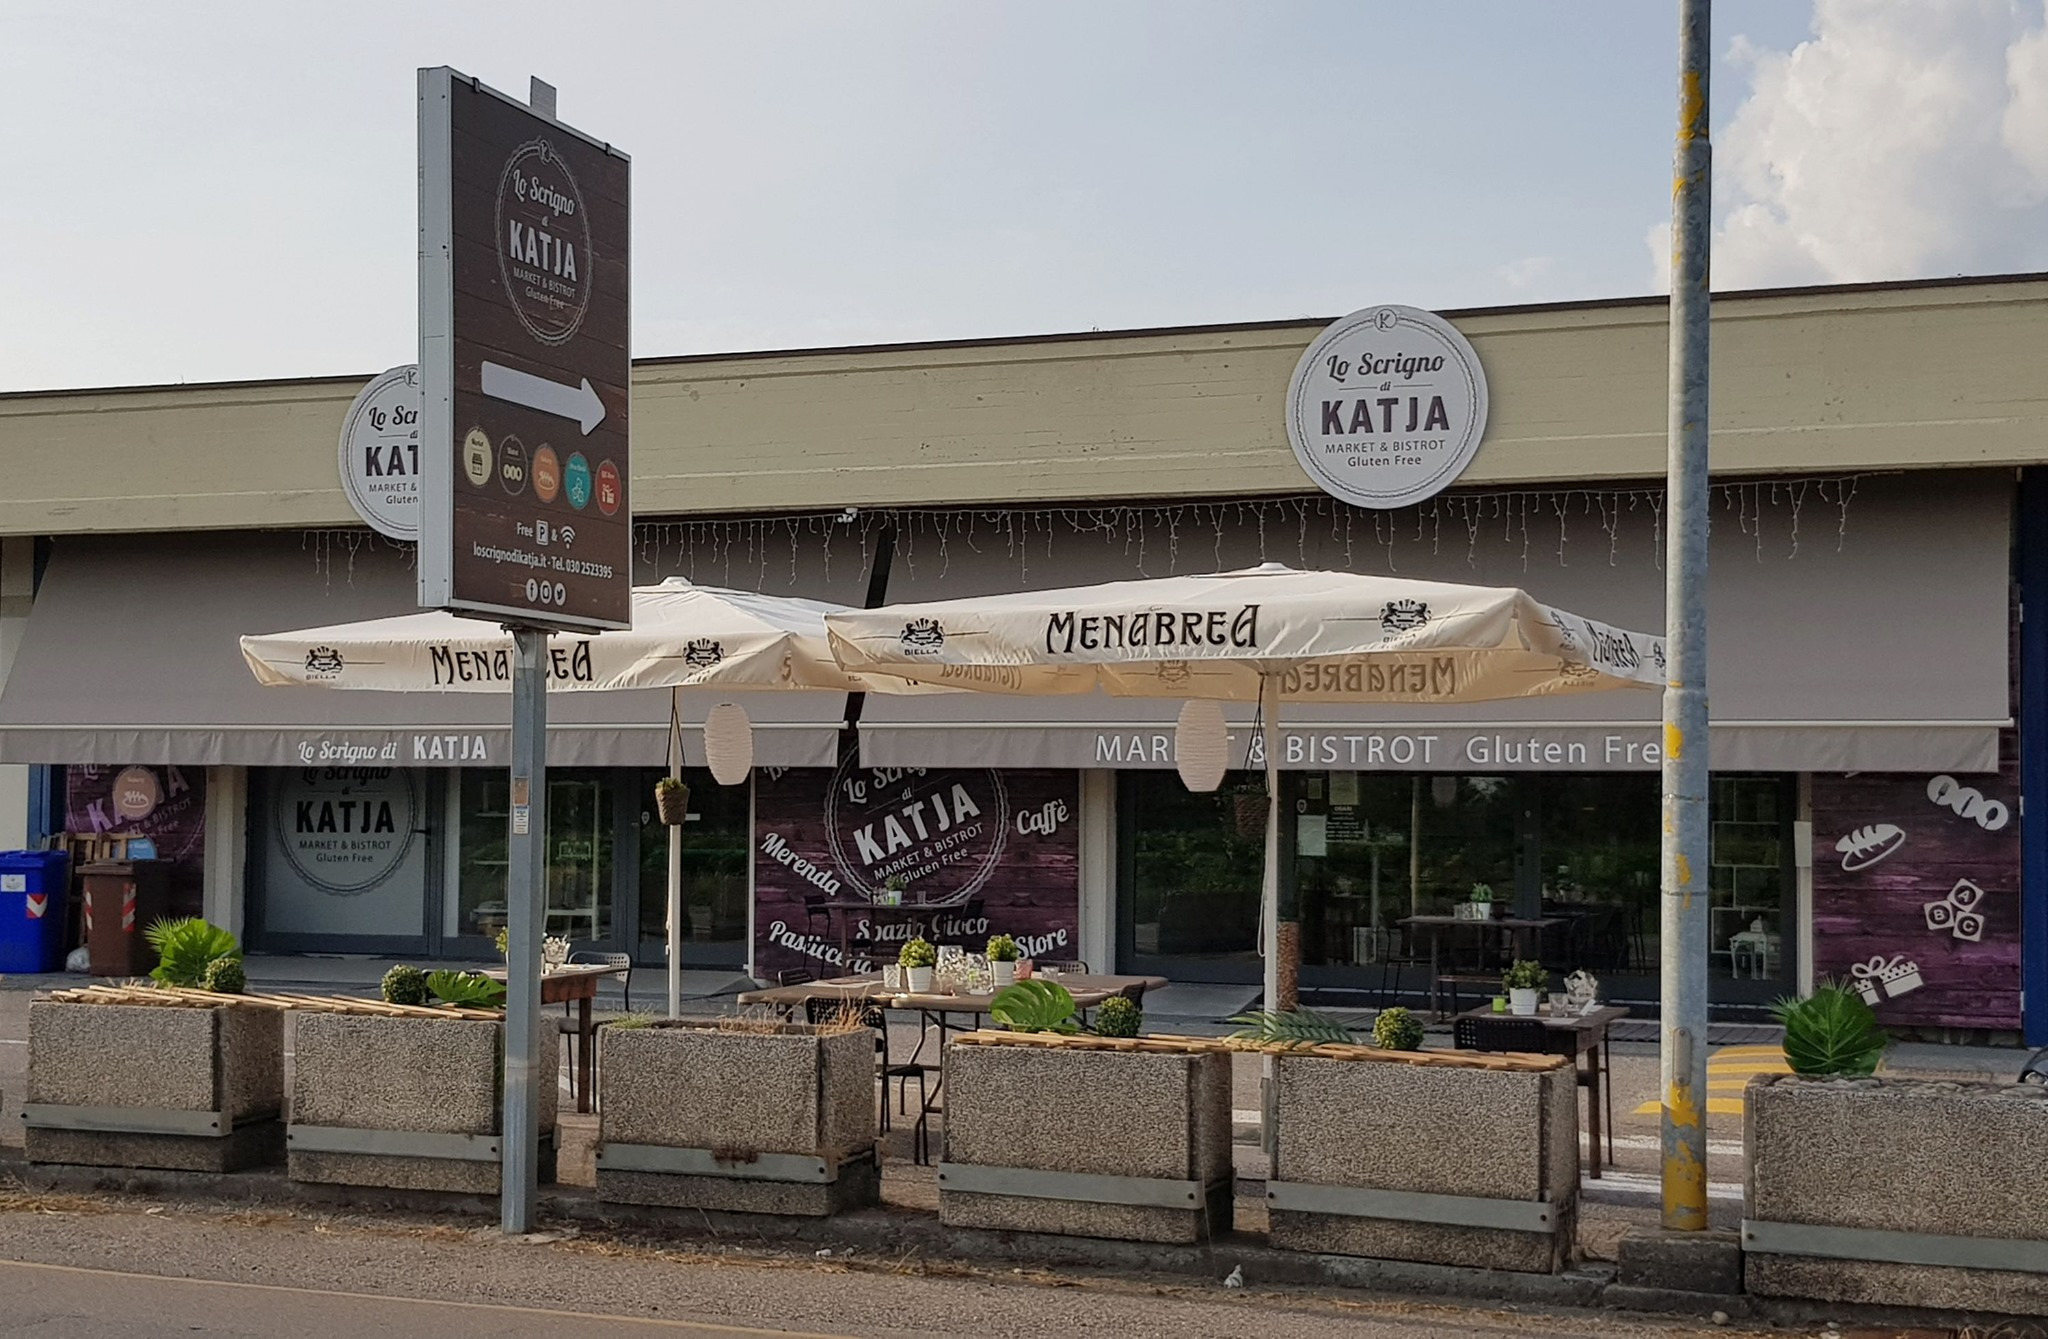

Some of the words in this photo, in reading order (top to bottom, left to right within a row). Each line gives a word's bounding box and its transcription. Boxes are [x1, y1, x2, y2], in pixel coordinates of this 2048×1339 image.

[513, 169, 527, 202] Lo
[530, 176, 575, 216] Scrigno
[510, 219, 577, 282] KATJA
[513, 266, 541, 286] MARKET
[548, 280, 576, 299] BISTROT
[525, 286, 549, 304] Gluten
[1379, 313, 1391, 329] K
[1327, 354, 1351, 383] Lo
[1358, 352, 1446, 380] Scrigno
[1380, 381, 1391, 391] di
[369, 406, 387, 431] Lo
[1321, 395, 1450, 435] KATJA
[366, 445, 418, 477] KAT
[1325, 442, 1375, 454] MARKET
[1380, 442, 1388, 451] &
[1393, 439, 1446, 451] BISTROT
[1347, 456, 1390, 467] Gluten
[1395, 455, 1422, 465] Free
[369, 483, 407, 492] MARKET
[386, 495, 418, 505] Gluten
[517, 522, 533, 537] Free
[551, 529, 558, 541] &
[473, 541, 547, 569] loscrignodikatja.it
[551, 556, 565, 571] Tel.
[566, 560, 580, 573] 030
[581, 562, 613, 579] 2523395
[1046, 604, 1261, 654] MENABREA
[430, 641, 593, 684] MENAEA
[298, 741, 314, 763] Lo
[319, 741, 377, 764] Scrigno
[381, 742, 398, 760] di
[413, 735, 487, 760] KATJA
[1286, 735, 1438, 763] BISTROT
[1466, 735, 1586, 763] Gluten
[1605, 736, 1660, 763] Fre
[843, 777, 867, 804] Lo
[296, 801, 394, 834] KATJA
[853, 783, 981, 866] KATJA
[1017, 799, 1070, 835] Caffè
[300, 840, 337, 850] MARKET
[341, 840, 347, 849] &
[351, 840, 391, 850] BISTROT
[316, 853, 349, 863] Gluten
[352, 854, 373, 862] Free
[873, 852, 920, 881] MARKET
[924, 847, 933, 858] &
[934, 822, 983, 853] BISTROT
[760, 832, 841, 896] Merenda
[900, 863, 940, 885] Gluten
[942, 847, 969, 867] Free
[1013, 928, 1067, 959] Store
